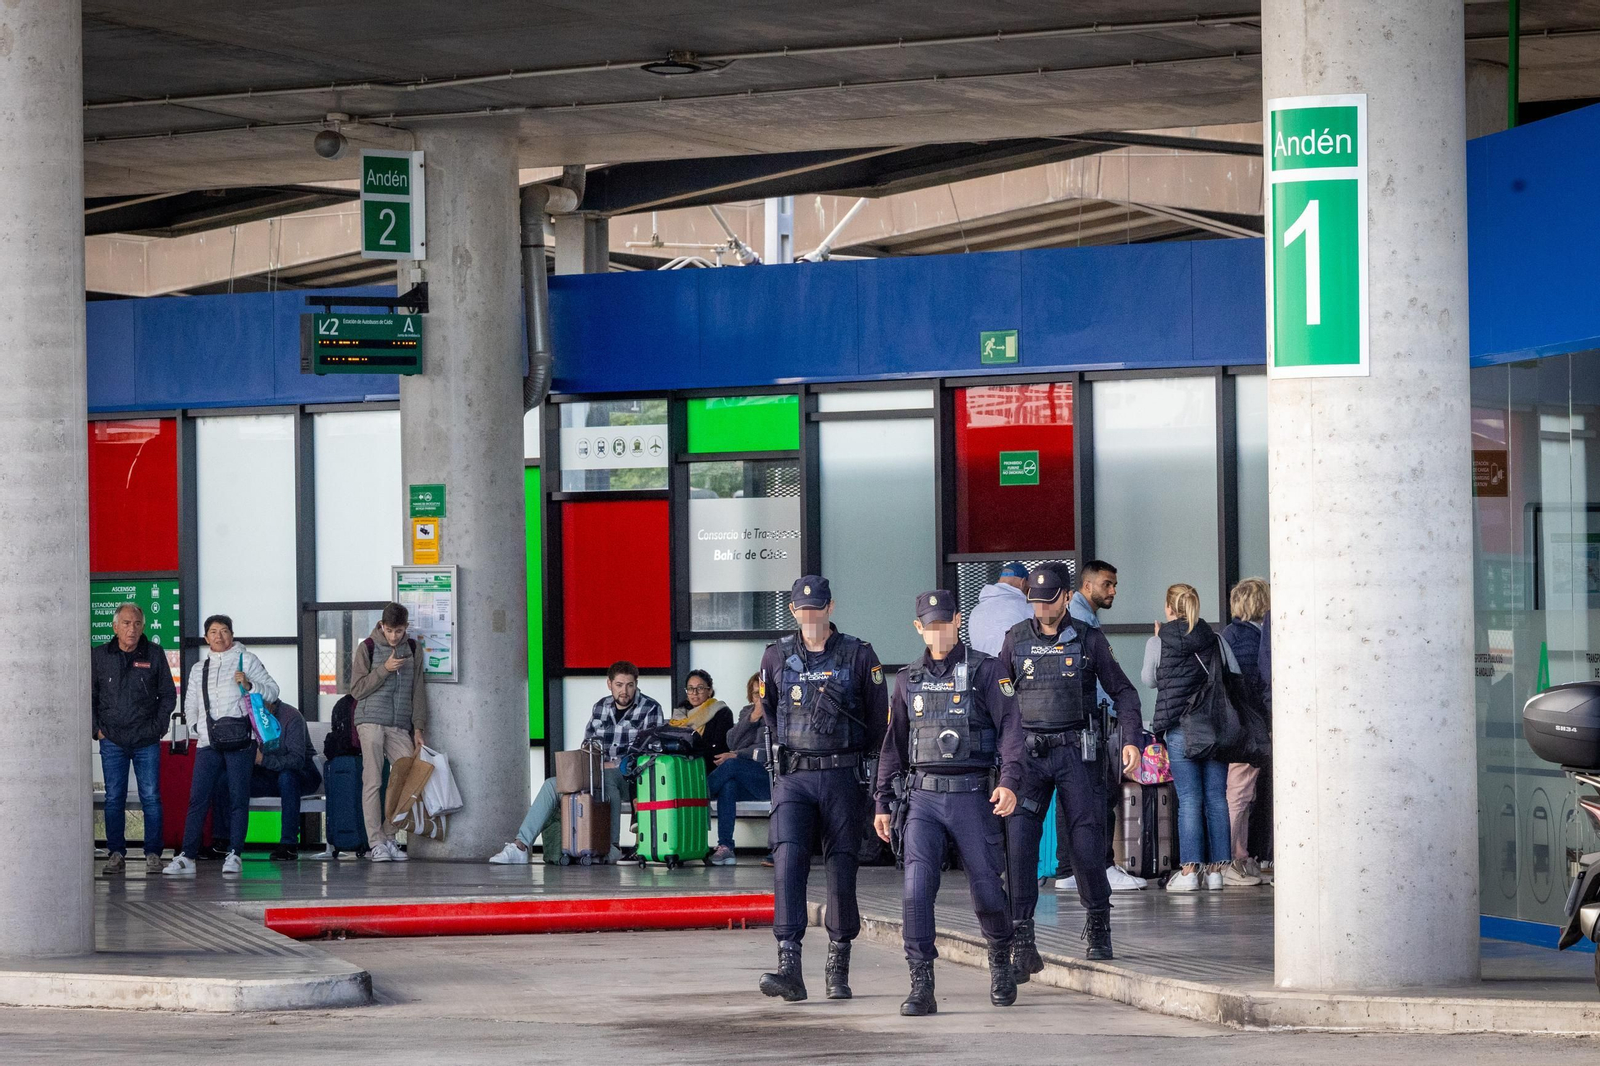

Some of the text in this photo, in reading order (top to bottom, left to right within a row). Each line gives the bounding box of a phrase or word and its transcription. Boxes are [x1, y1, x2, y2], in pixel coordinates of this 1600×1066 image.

[1273, 128, 1352, 158] Andén
[366, 169, 408, 187] Andén
[379, 208, 397, 246] 2
[1283, 199, 1321, 325] 1
[330, 318, 339, 335] 2
[697, 529, 739, 540] Consorcio
[741, 528, 752, 539] de
[714, 549, 742, 560] Bahía
[745, 549, 756, 560] de
[1555, 725, 1577, 733] SH34
